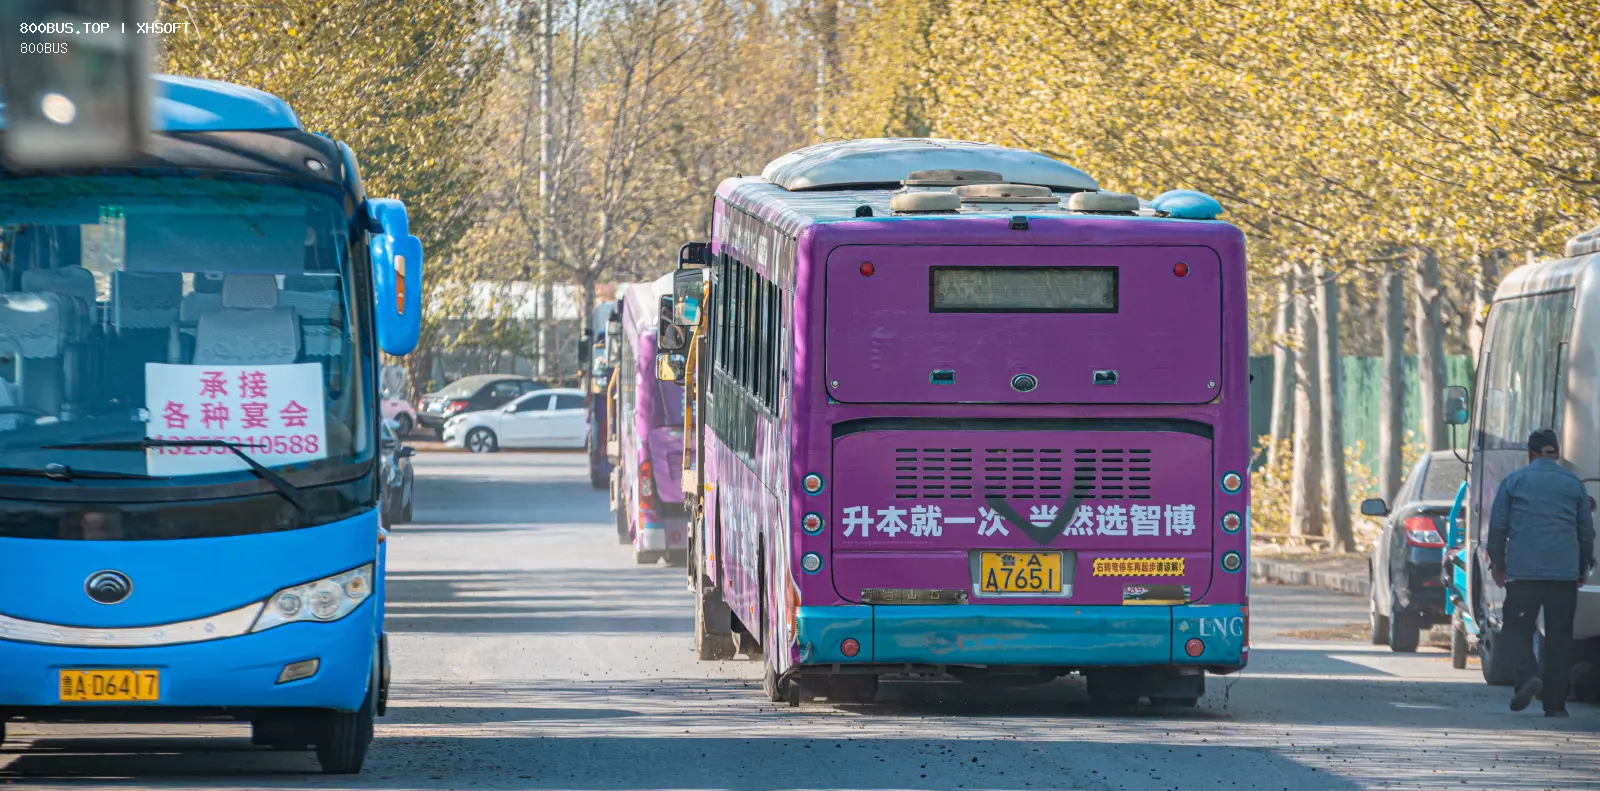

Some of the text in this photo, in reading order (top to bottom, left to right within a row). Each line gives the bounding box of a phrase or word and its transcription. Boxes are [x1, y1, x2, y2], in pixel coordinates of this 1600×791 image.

[199, 370, 268, 399] 承接
[162, 400, 309, 430] 各种宴会
[842, 504, 1197, 538] 升本就一次 当然选智博
[985, 568, 1053, 590] A7651
[1199, 616, 1244, 637] LNG
